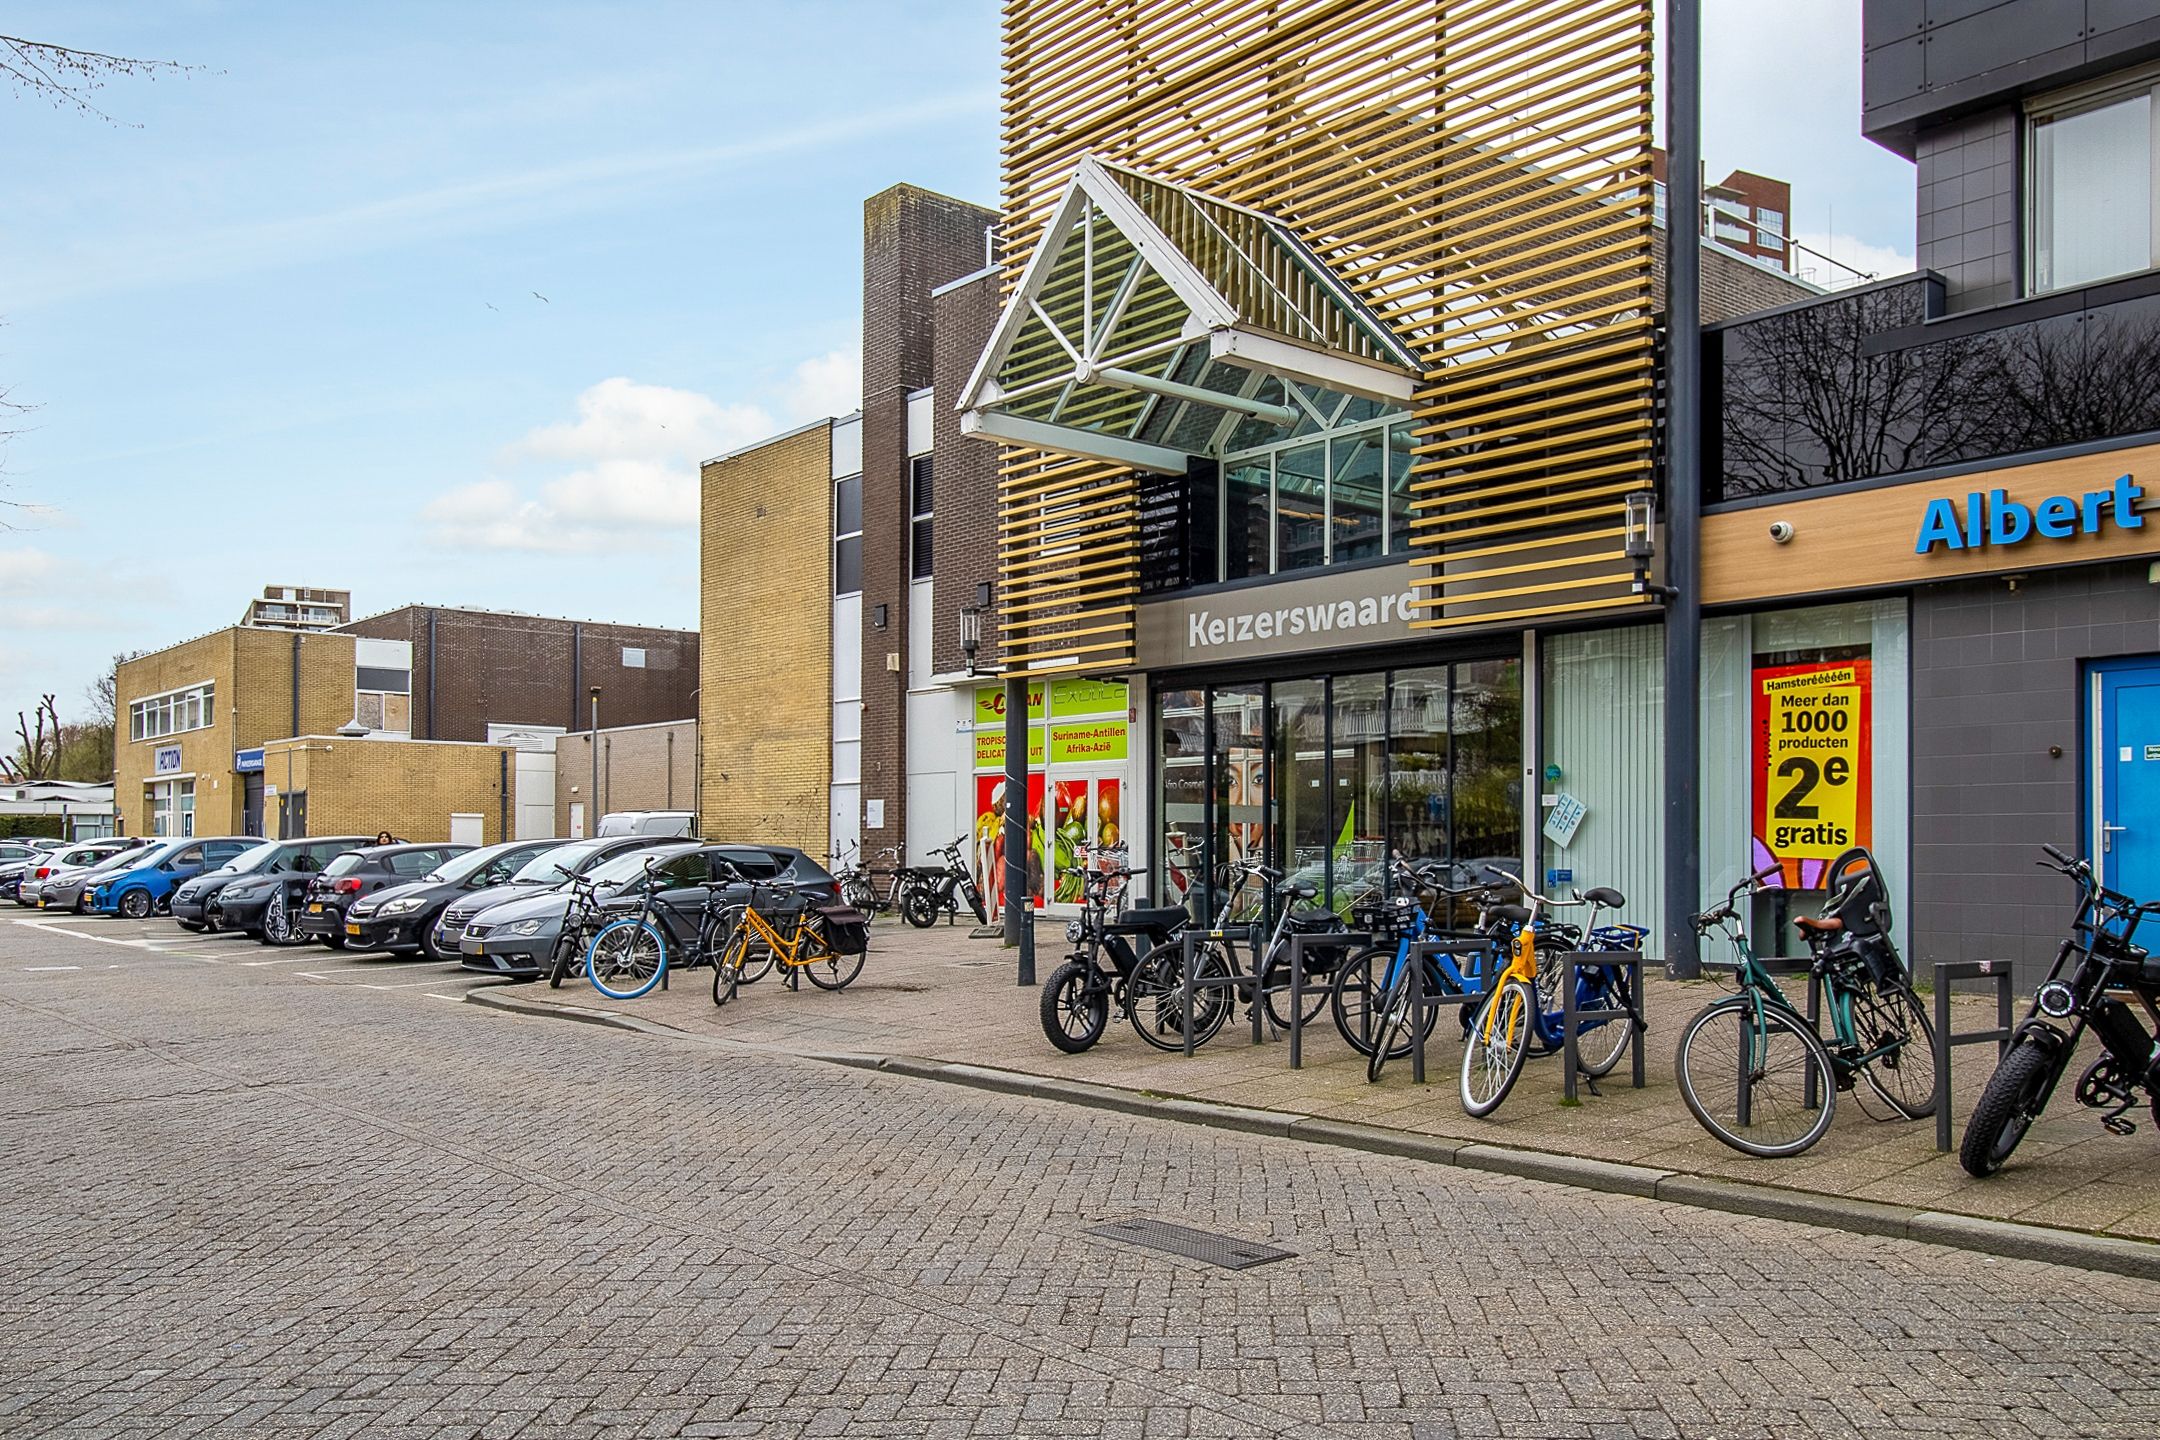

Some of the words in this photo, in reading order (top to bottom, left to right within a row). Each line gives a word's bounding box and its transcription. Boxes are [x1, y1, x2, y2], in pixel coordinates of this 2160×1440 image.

[1915, 473, 2146, 554] Albert
[1188, 587, 1420, 648] Keizerswaard
[1781, 695, 1818, 707] Meer
[1822, 693, 1849, 706] dan
[1781, 710, 1848, 733] 1000
[977, 736, 1007, 746] TROPISC
[1053, 728, 1126, 741] Suriname-Antillen
[1066, 741, 1111, 754] Afrika-Azië
[1778, 737, 1848, 750] producten
[159, 749, 181, 770] ACTION
[977, 749, 1006, 759] DELICAT
[1030, 747, 1043, 756] UIT
[1774, 756, 1850, 819] 2e
[1775, 822, 1848, 849] gratis
